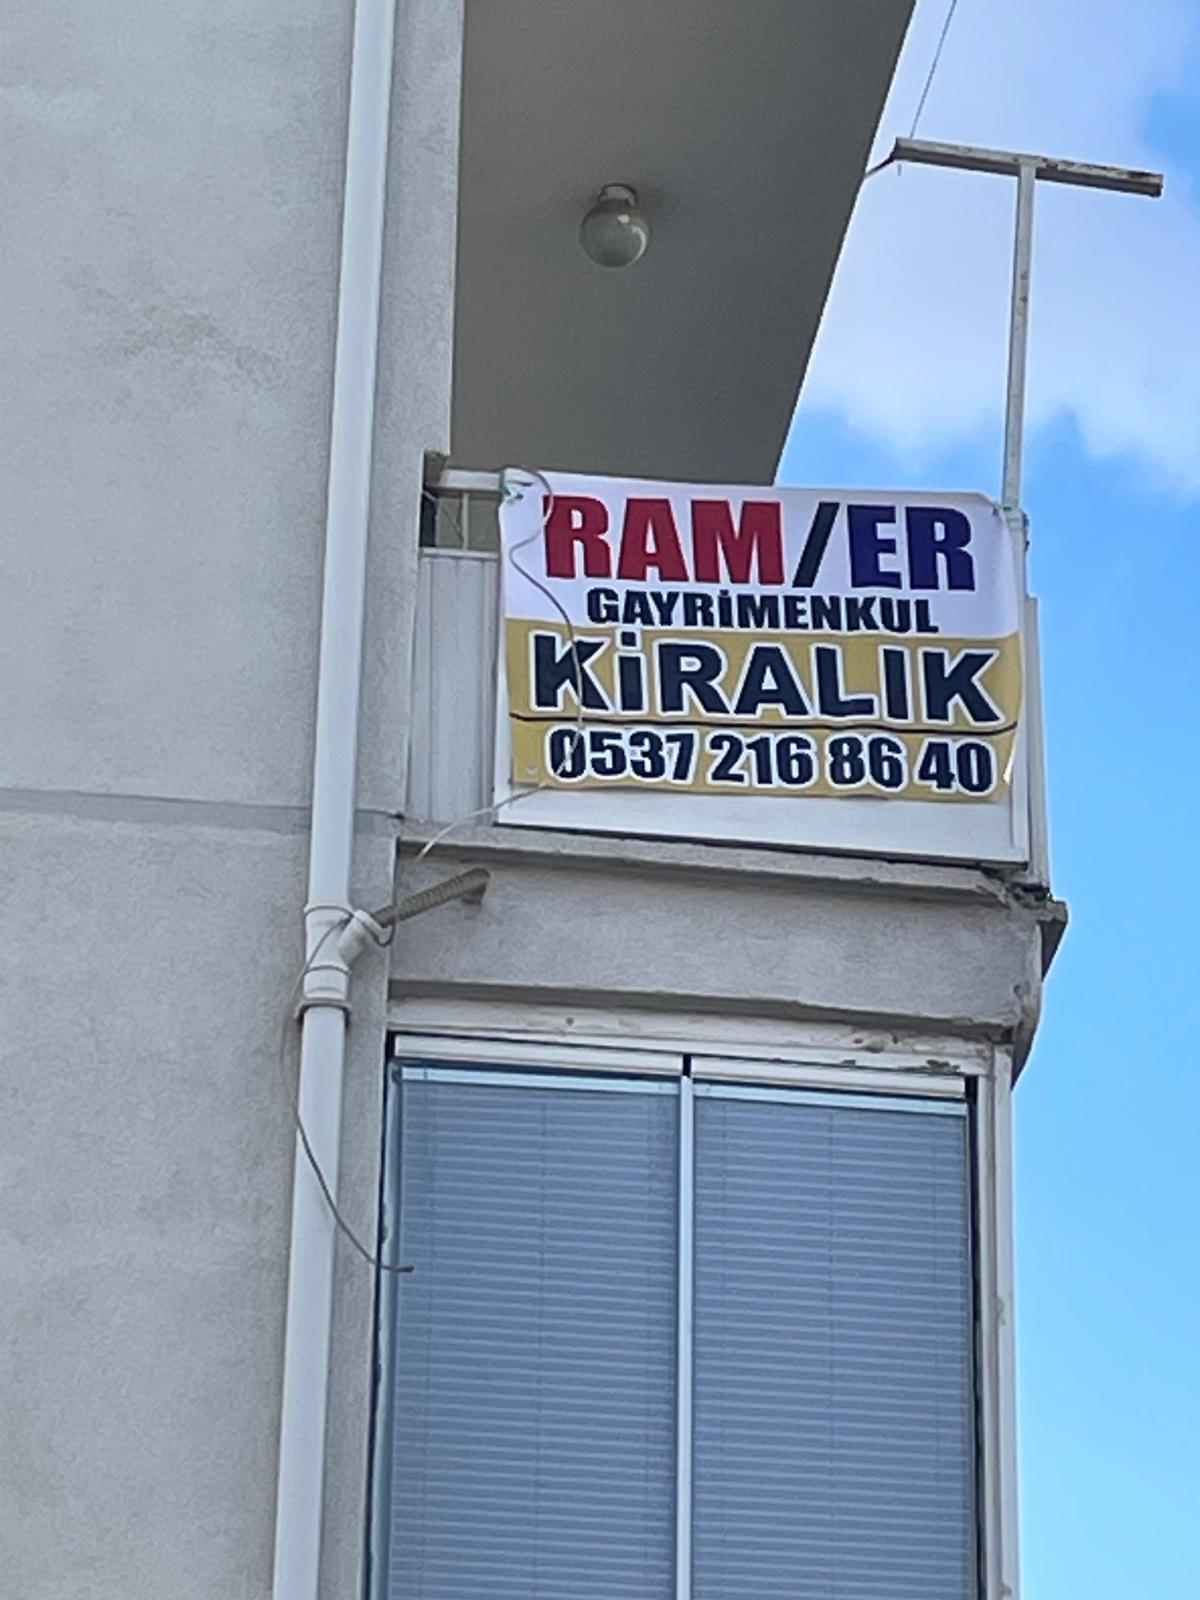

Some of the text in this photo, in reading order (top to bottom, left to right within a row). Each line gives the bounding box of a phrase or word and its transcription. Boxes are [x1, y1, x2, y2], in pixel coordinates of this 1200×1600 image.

[586, 588, 939, 634] GAYRİMENKUL
[549, 728, 993, 793] 0537 216 86 40
